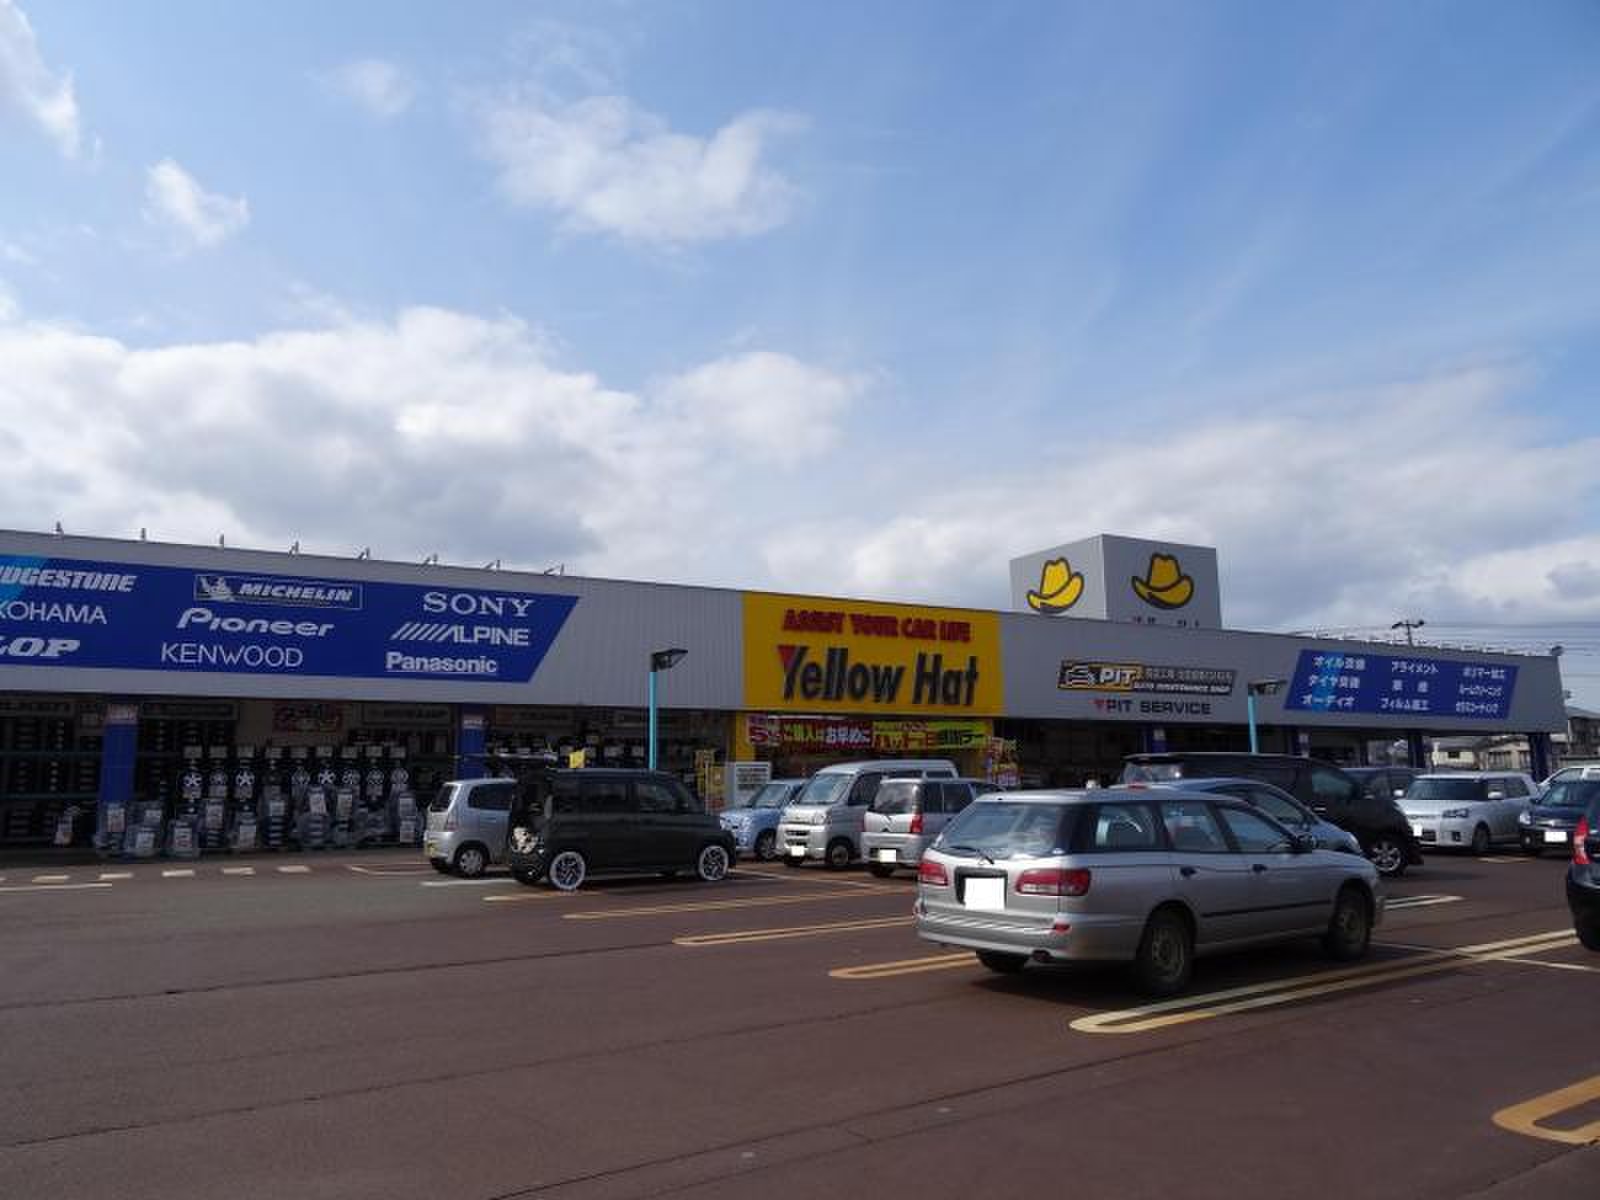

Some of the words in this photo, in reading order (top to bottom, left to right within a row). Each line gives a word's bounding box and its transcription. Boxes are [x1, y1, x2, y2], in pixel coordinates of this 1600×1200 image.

[239, 582, 353, 602] MICHELIN
[423, 591, 534, 618] SONY
[175, 607, 335, 637] Pioneer
[436, 623, 531, 646] ALPINE
[160, 642, 304, 668] KENWOOD
[385, 651, 497, 673] Panasonic
[777, 643, 906, 703] Yellow
[912, 651, 980, 706] Hat
[1100, 668, 1136, 684] PIT
[1106, 700, 1132, 713] PIT
[1140, 701, 1212, 715] SERVICE
